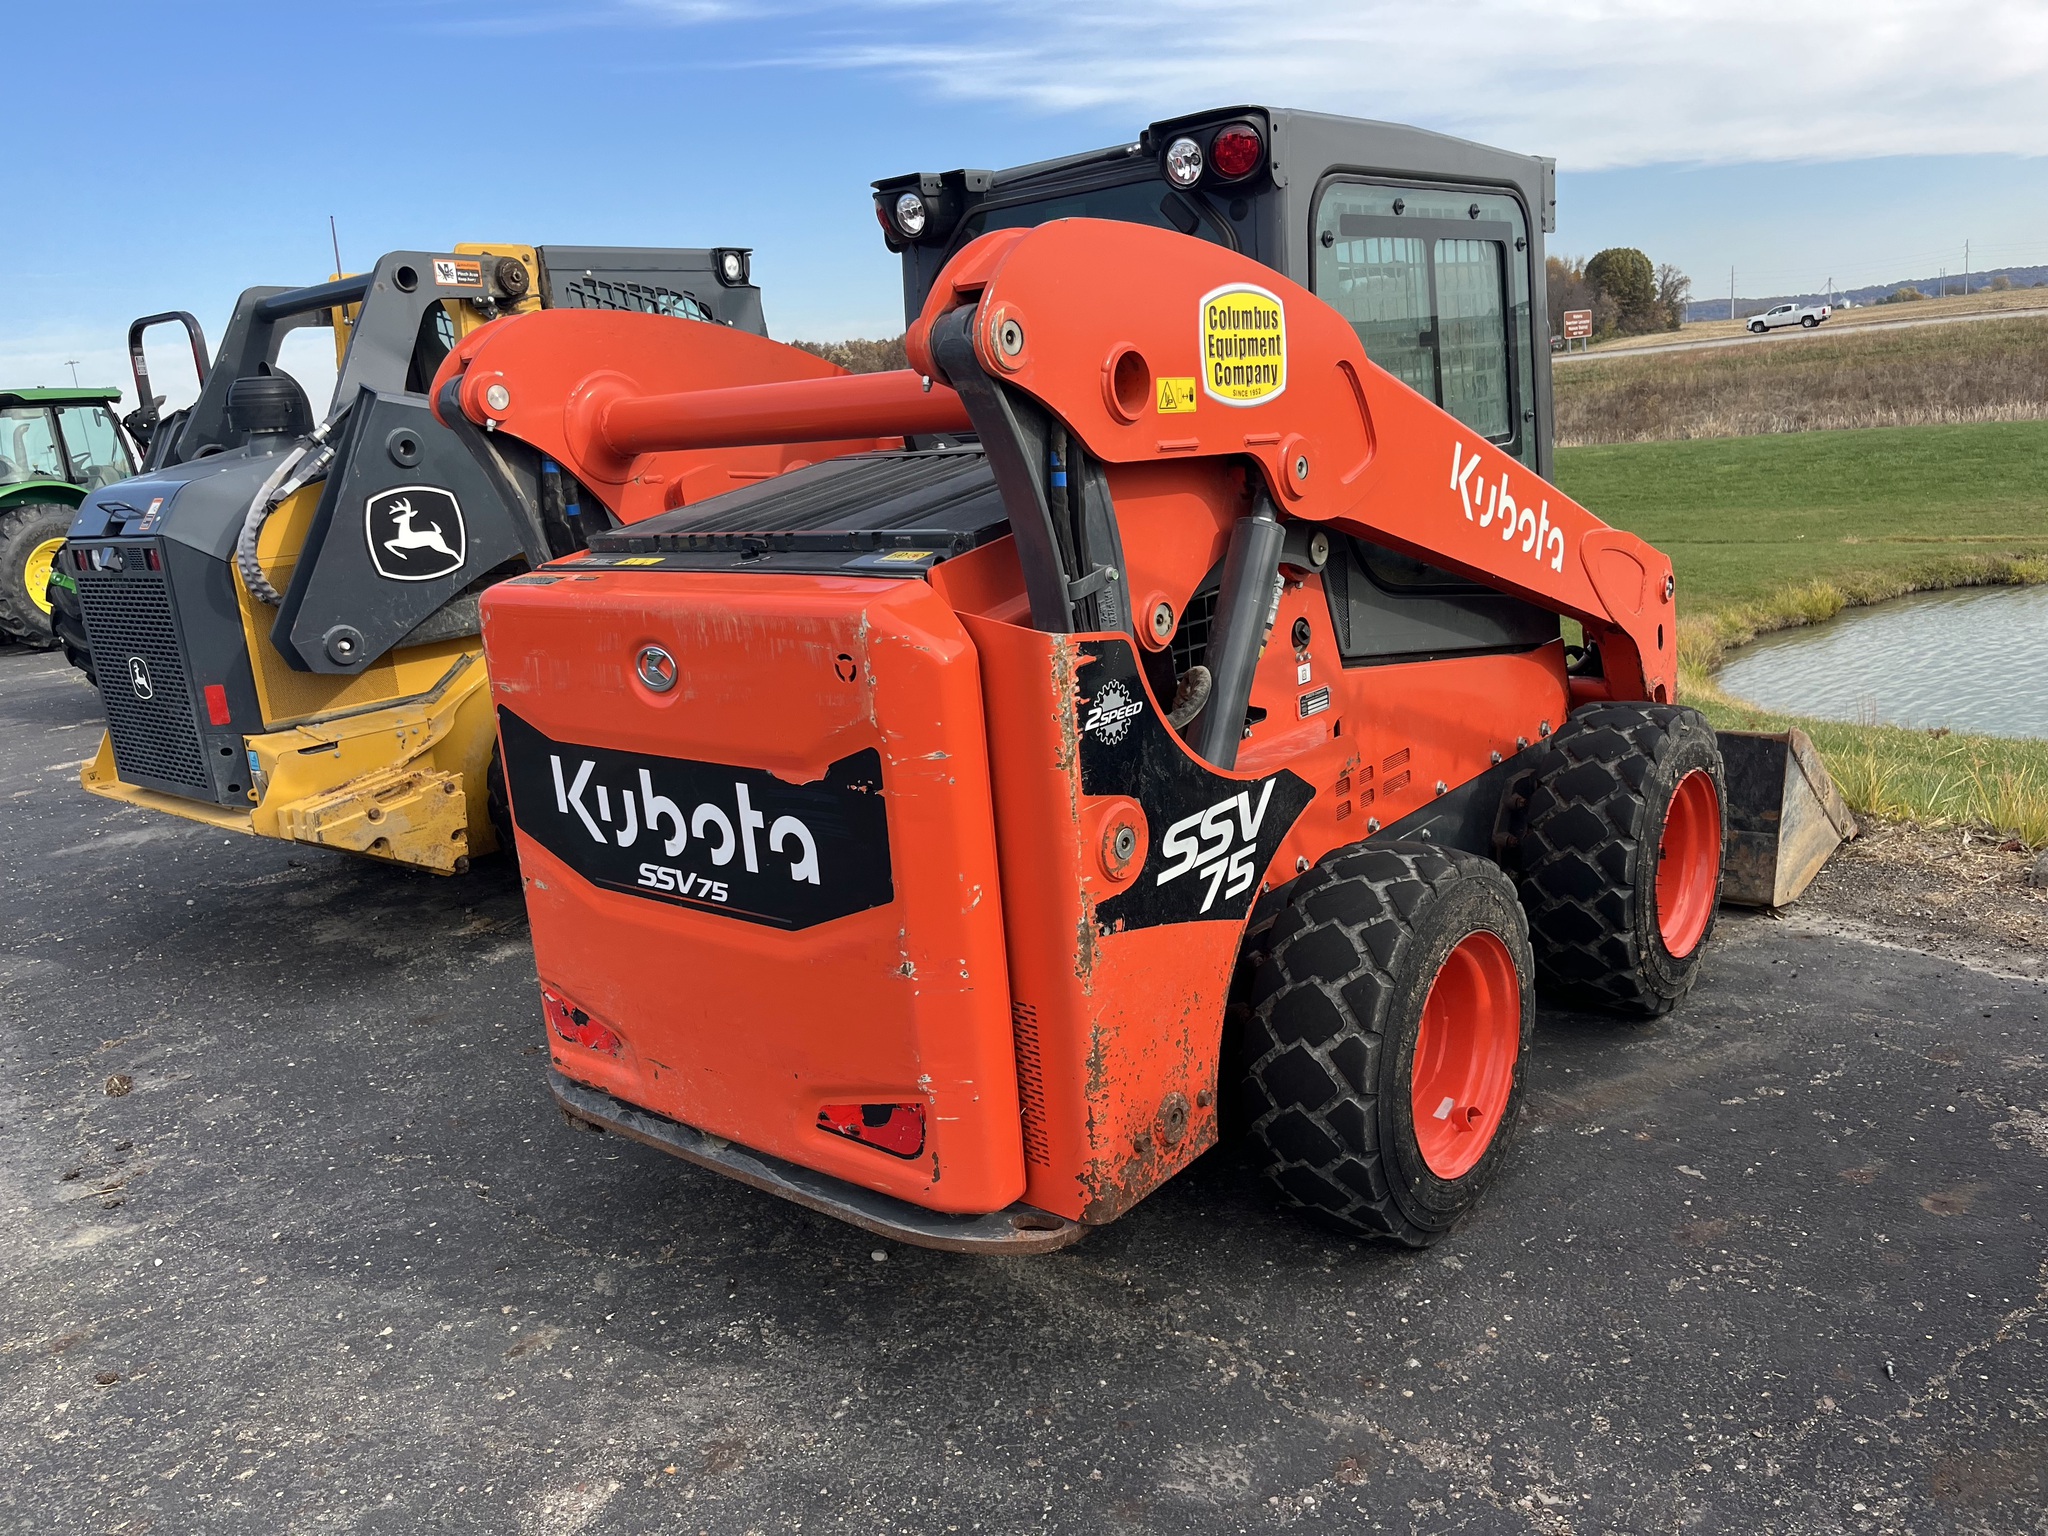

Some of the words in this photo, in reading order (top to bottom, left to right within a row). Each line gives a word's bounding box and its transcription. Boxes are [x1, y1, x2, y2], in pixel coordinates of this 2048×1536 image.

[1208, 305, 1279, 331] Columbus
[1208, 334, 1282, 361] Equipment
[1214, 362, 1279, 387] Company
[1232, 389, 1249, 398] SINCE
[1249, 388, 1262, 397] 1952
[1449, 440, 1565, 574] Kubota
[549, 754, 821, 886] Kubota
[1156, 777, 1277, 887] SSV
[1199, 842, 1257, 915] 75
